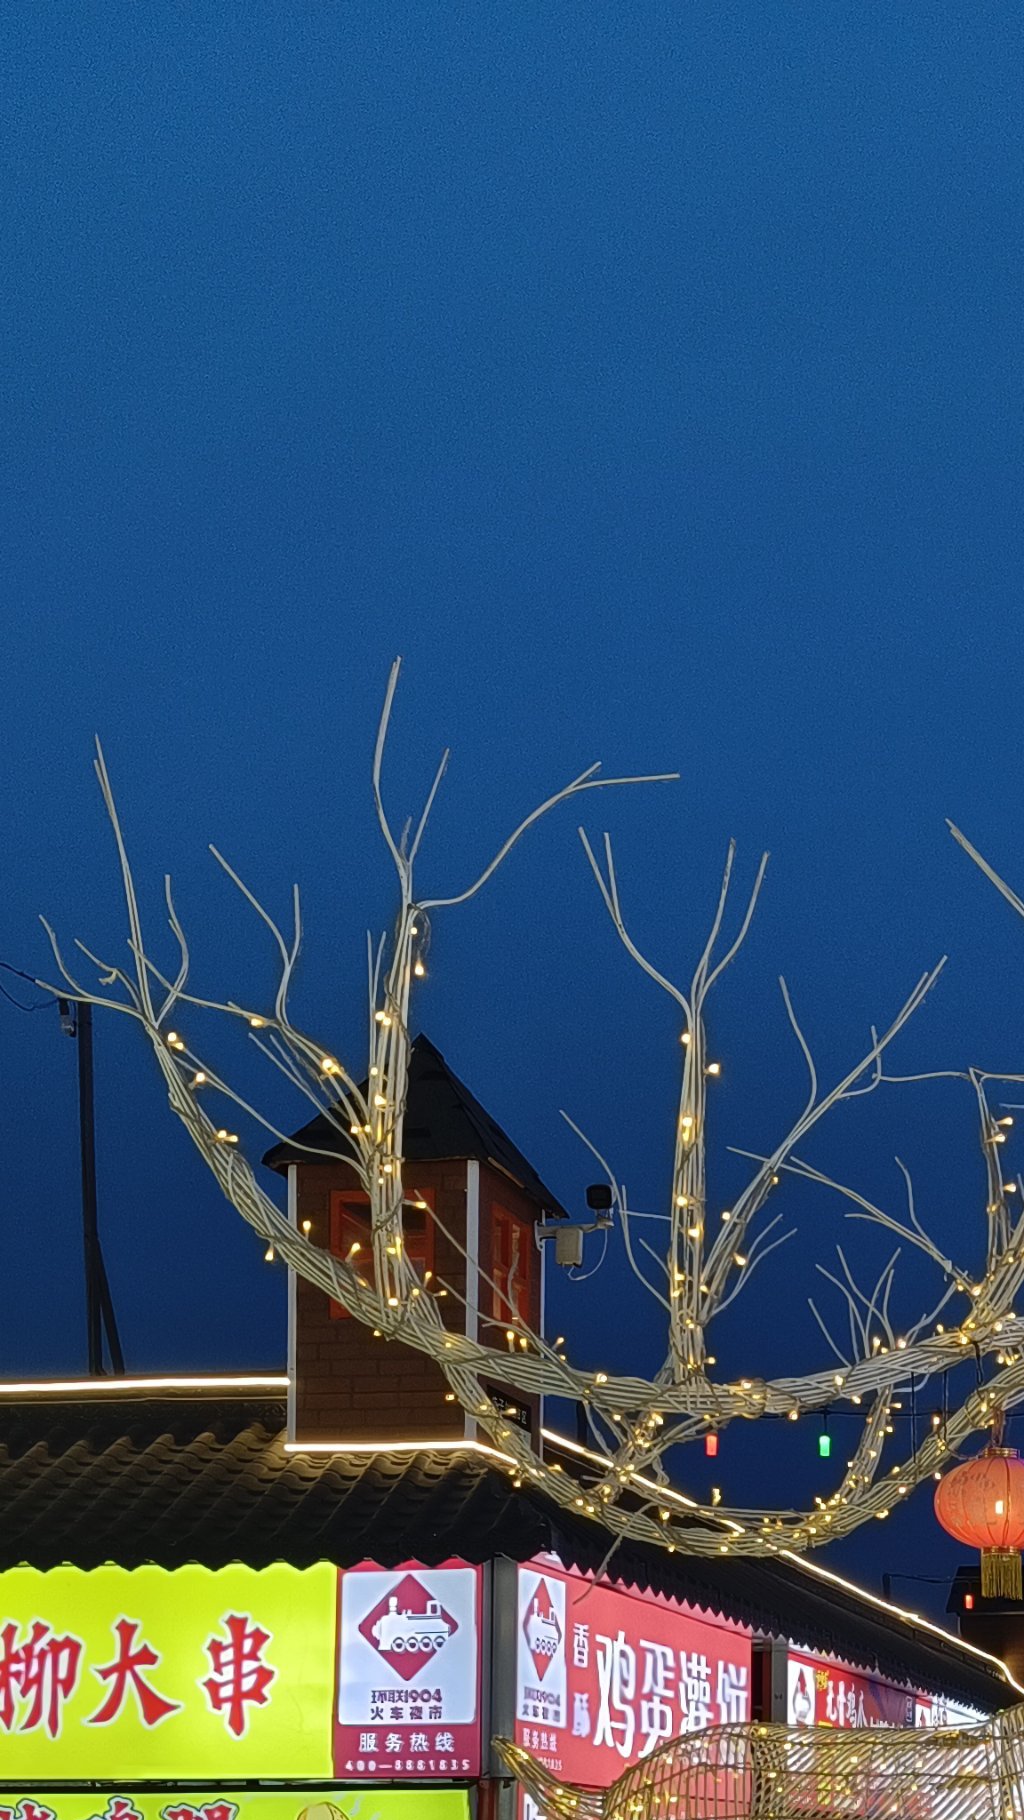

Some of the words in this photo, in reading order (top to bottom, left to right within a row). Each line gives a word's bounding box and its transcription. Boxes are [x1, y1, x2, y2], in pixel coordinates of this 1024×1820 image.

[370, 1688, 443, 1704] 环联1904
[370, 1705, 443, 1721] 火车夜市
[358, 1732, 456, 1753] 服务热线
